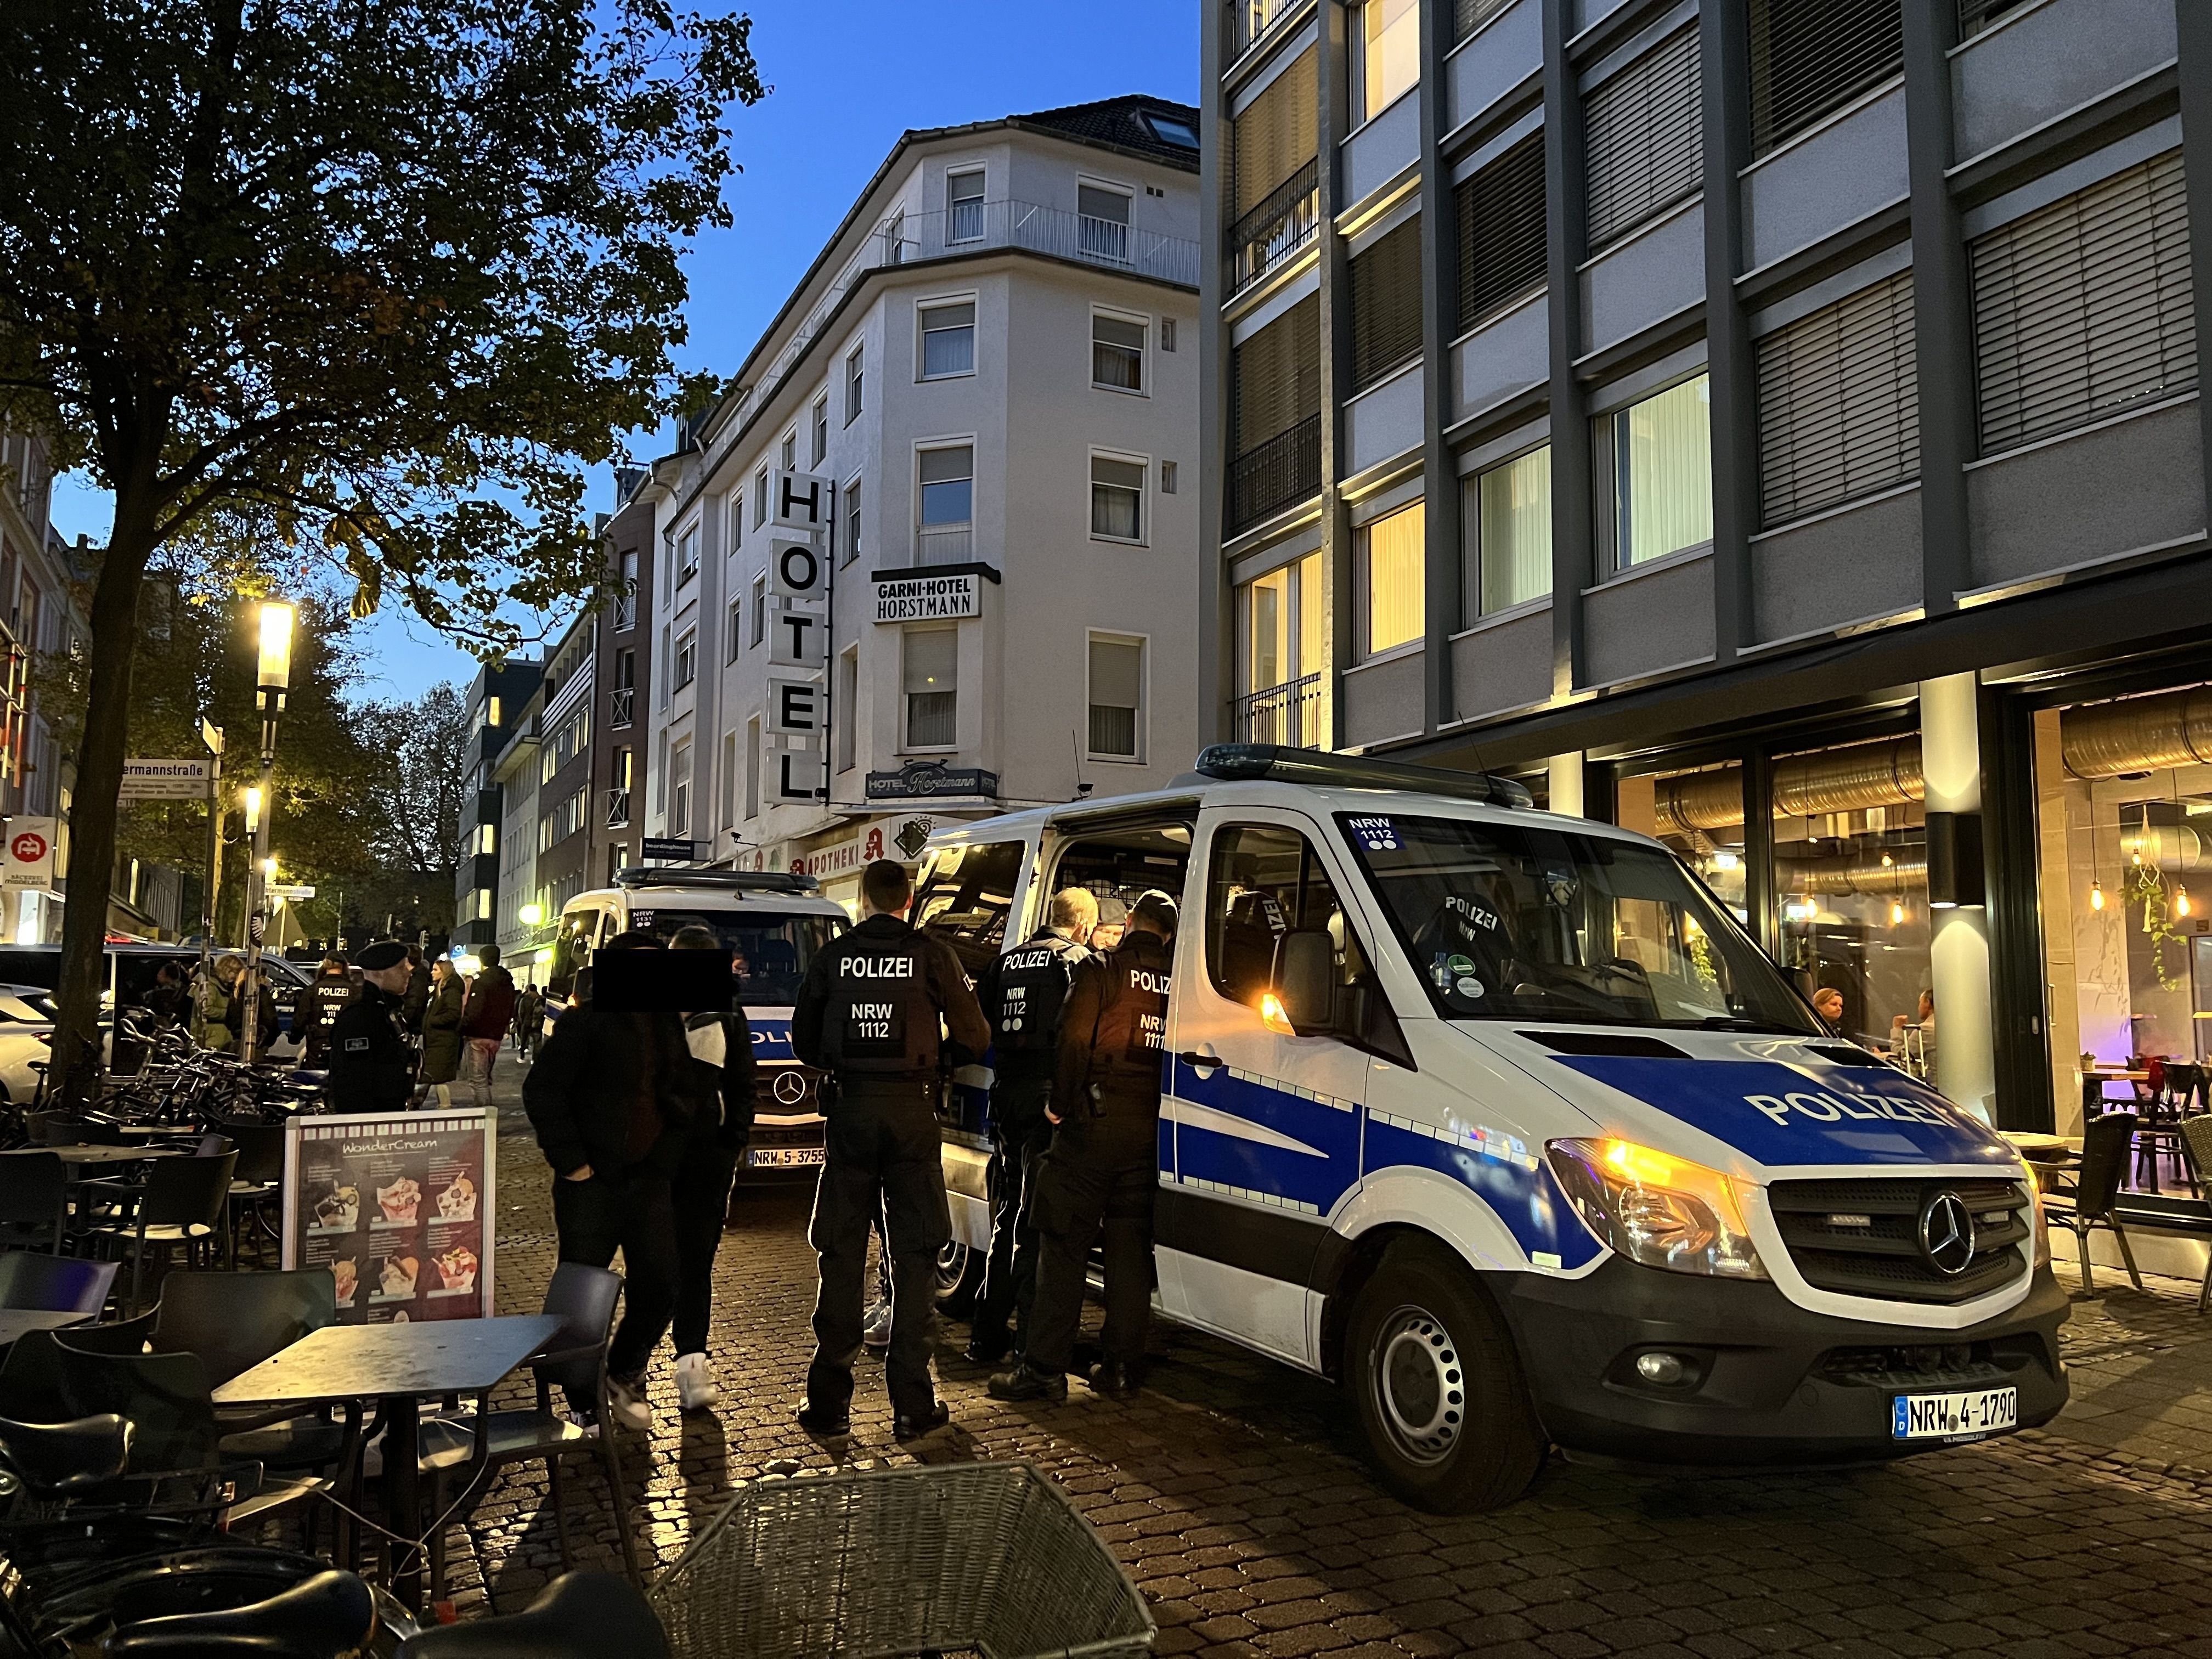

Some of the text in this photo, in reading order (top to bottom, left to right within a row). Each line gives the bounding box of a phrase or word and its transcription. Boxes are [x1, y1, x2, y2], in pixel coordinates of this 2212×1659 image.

[878, 578, 970, 599] GARNI-HOTEL
[877, 595, 970, 619] HORSTMANN
[781, 476, 818, 798] HOTEL
[122, 764, 203, 776] ermannstraße
[868, 771, 976, 794] HOTEL Horstmann
[1348, 818, 1390, 828] NRW
[1361, 830, 1395, 839] 1112
[1262, 900, 1286, 940] IZEI
[1446, 896, 1498, 931] POLIZEI
[840, 957, 913, 978] POLIZEI
[1003, 950, 1051, 971] POLIZEI
[318, 988, 349, 996] POLIZEI
[1131, 970, 1171, 994] POLIZ
[1006, 987, 1025, 1000] NRW
[851, 1003, 893, 1019] NRW
[1003, 1001, 1026, 1016] 1112
[858, 1022, 889, 1037] 1112
[1743, 1092, 1958, 1126] POLIZEI
[342, 1139, 437, 1154] WonderCream
[755, 1150, 824, 1164] NRW 5-3755
[1910, 1398, 1948, 1431] NRW
[1960, 1391, 2015, 1428] 4-1790
